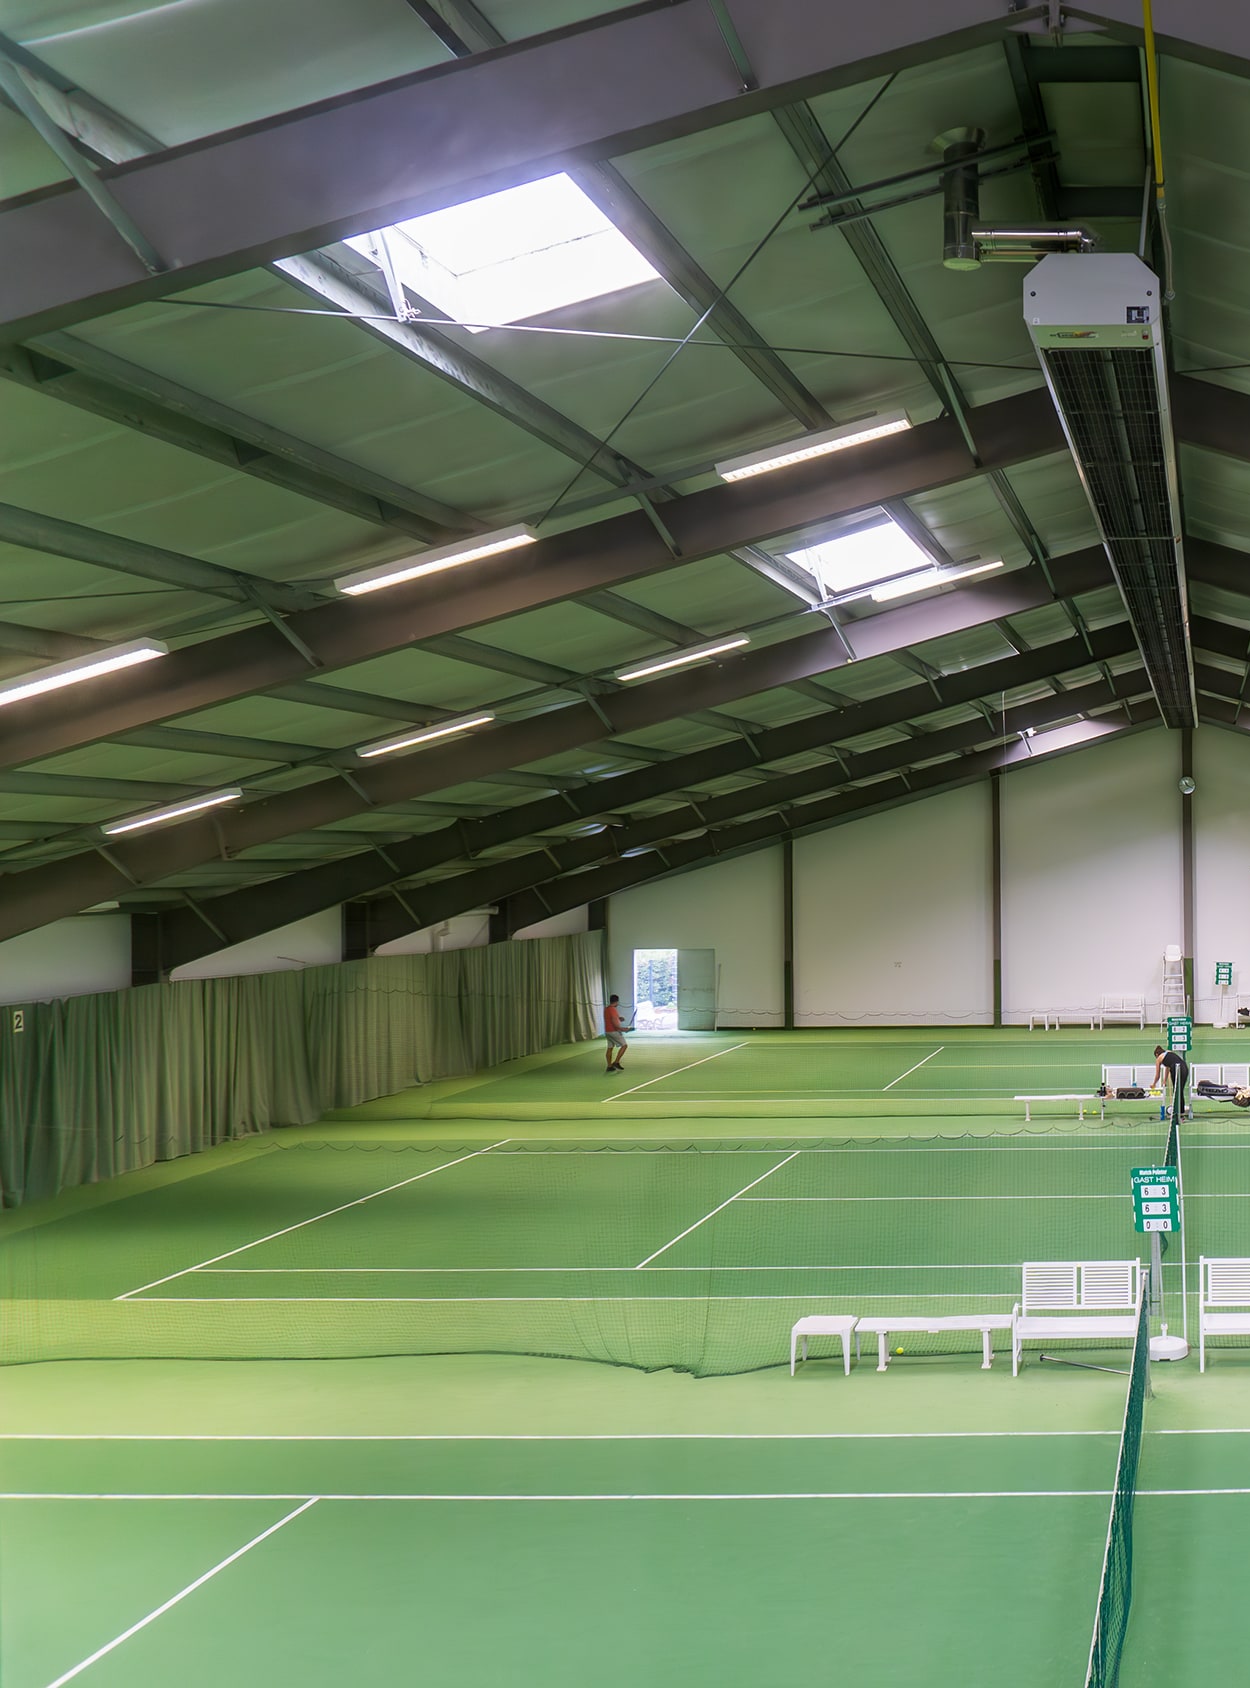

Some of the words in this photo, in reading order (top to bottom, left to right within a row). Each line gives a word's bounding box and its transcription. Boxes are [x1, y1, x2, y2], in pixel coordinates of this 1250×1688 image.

[15, 1014, 22, 1029] 2
[1156, 1175, 1175, 1183] HEIM
[1144, 1187, 1149, 1196] 6
[1161, 1187, 1166, 1195] 3
[1145, 1204, 1150, 1213] 6
[1162, 1203, 1167, 1212] 3
[1146, 1221, 1151, 1229] 0
[1163, 1220, 1168, 1229] 0
